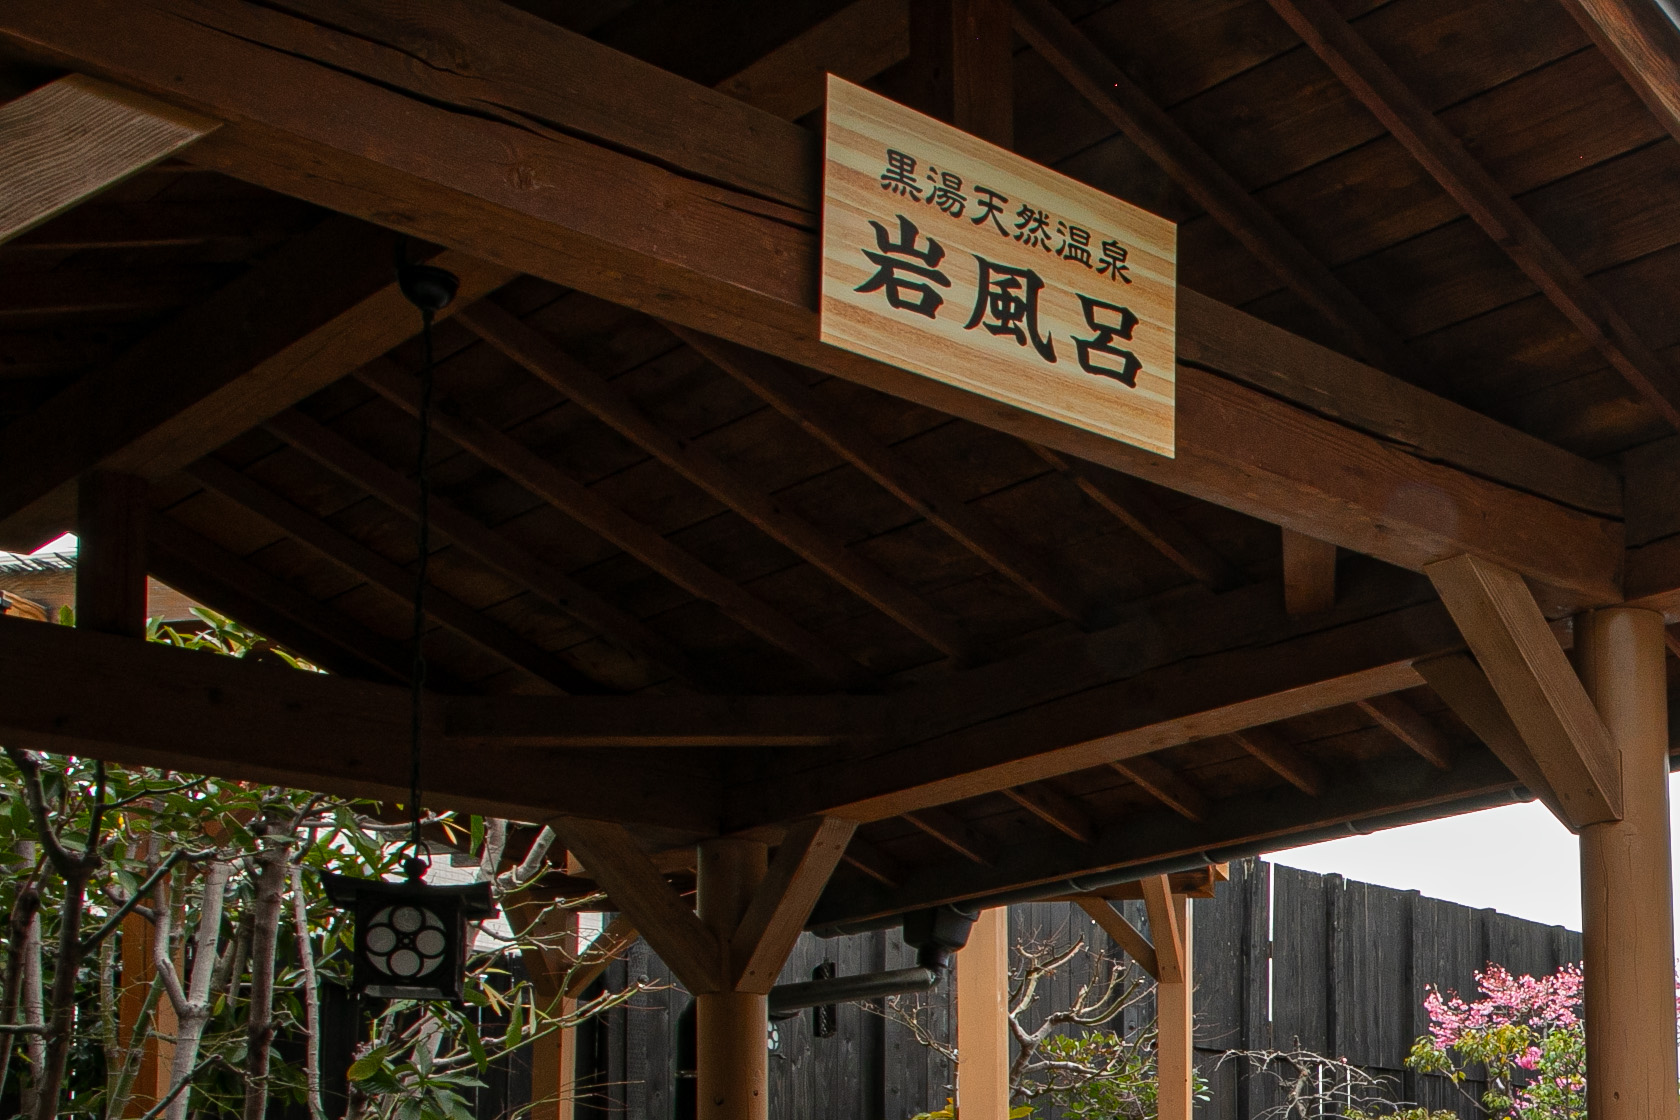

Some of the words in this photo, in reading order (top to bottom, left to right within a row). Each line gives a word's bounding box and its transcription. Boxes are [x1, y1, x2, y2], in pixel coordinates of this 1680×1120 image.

[880, 148, 1133, 285] 黒湯天然温泉
[853, 213, 1144, 389] 岩風呂
